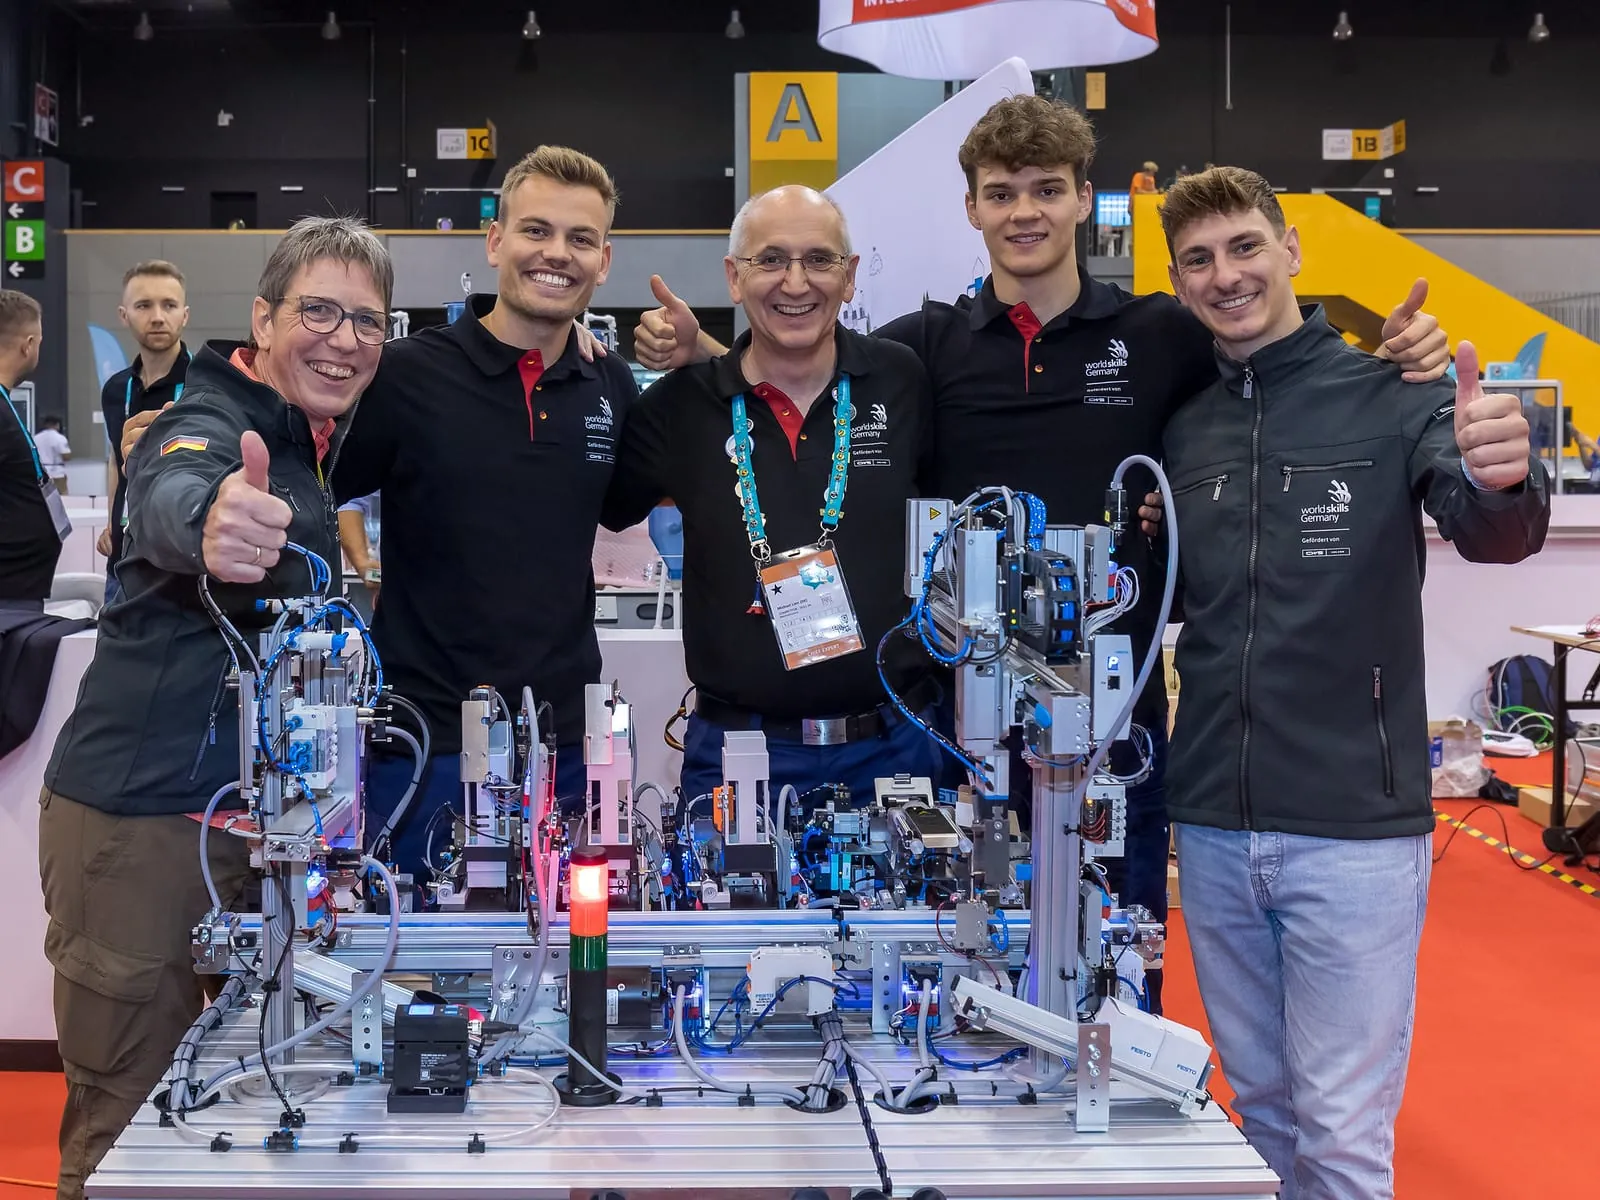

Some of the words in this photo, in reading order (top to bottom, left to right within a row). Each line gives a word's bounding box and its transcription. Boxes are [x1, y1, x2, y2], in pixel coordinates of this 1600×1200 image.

[766, 83, 823, 142] A
[1356, 137, 1377, 152] 1B
[13, 167, 36, 195] C
[15, 226, 35, 253] B
[1085, 368, 1120, 377] Germany
[584, 421, 610, 433] Germany
[850, 431, 881, 439] Germany
[1300, 513, 1340, 524] Germany
[1130, 1046, 1152, 1058] FESTO
[1176, 1063, 1197, 1075] FESTO
